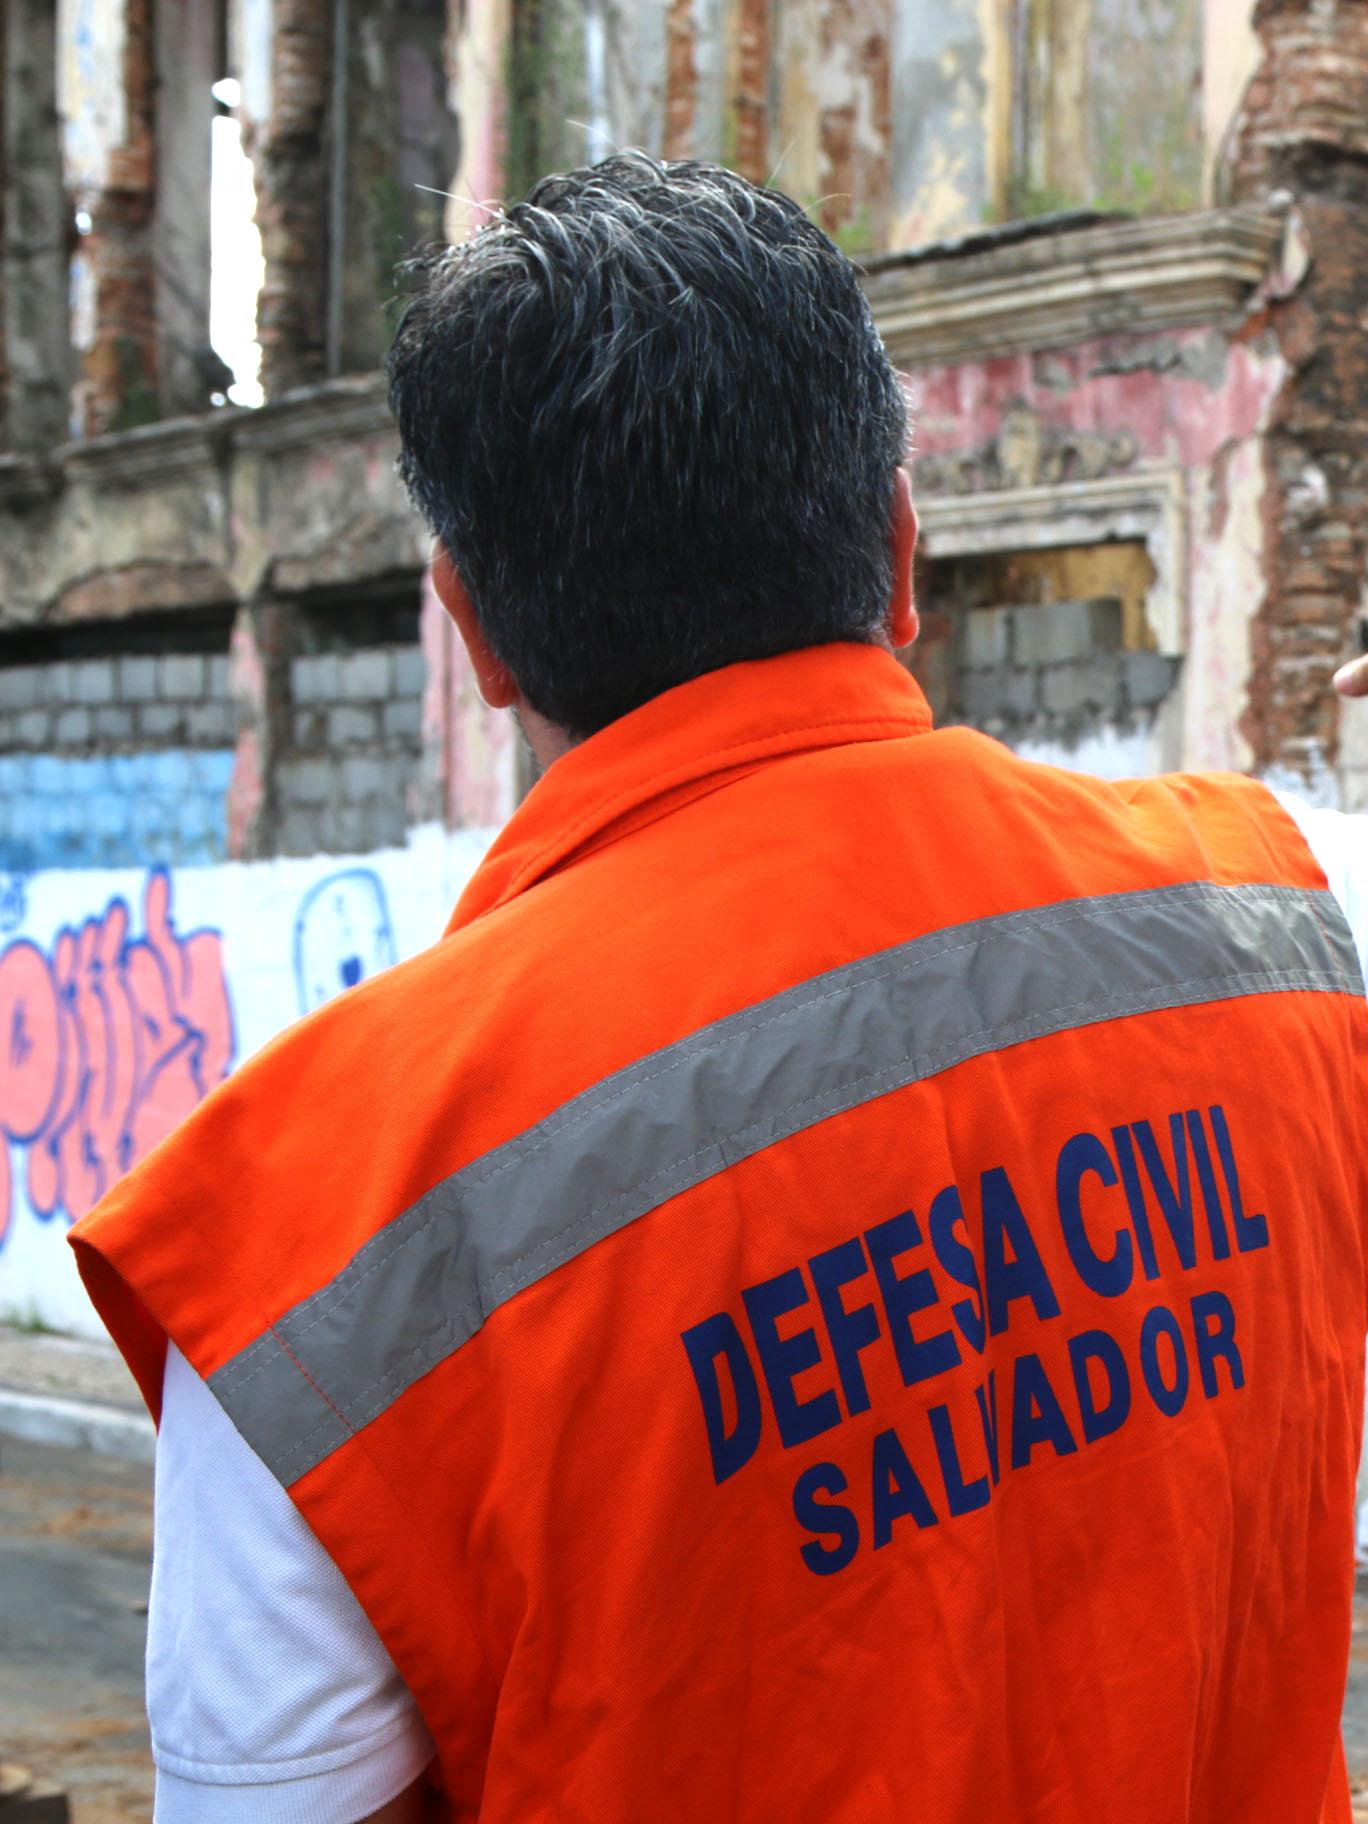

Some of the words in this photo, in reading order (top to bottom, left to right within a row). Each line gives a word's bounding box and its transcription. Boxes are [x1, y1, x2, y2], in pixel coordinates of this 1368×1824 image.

[680, 1165, 1061, 1486] DEFESA
[1055, 1104, 1269, 1298] CIVIL
[791, 1290, 1245, 1577] SALVADOR
